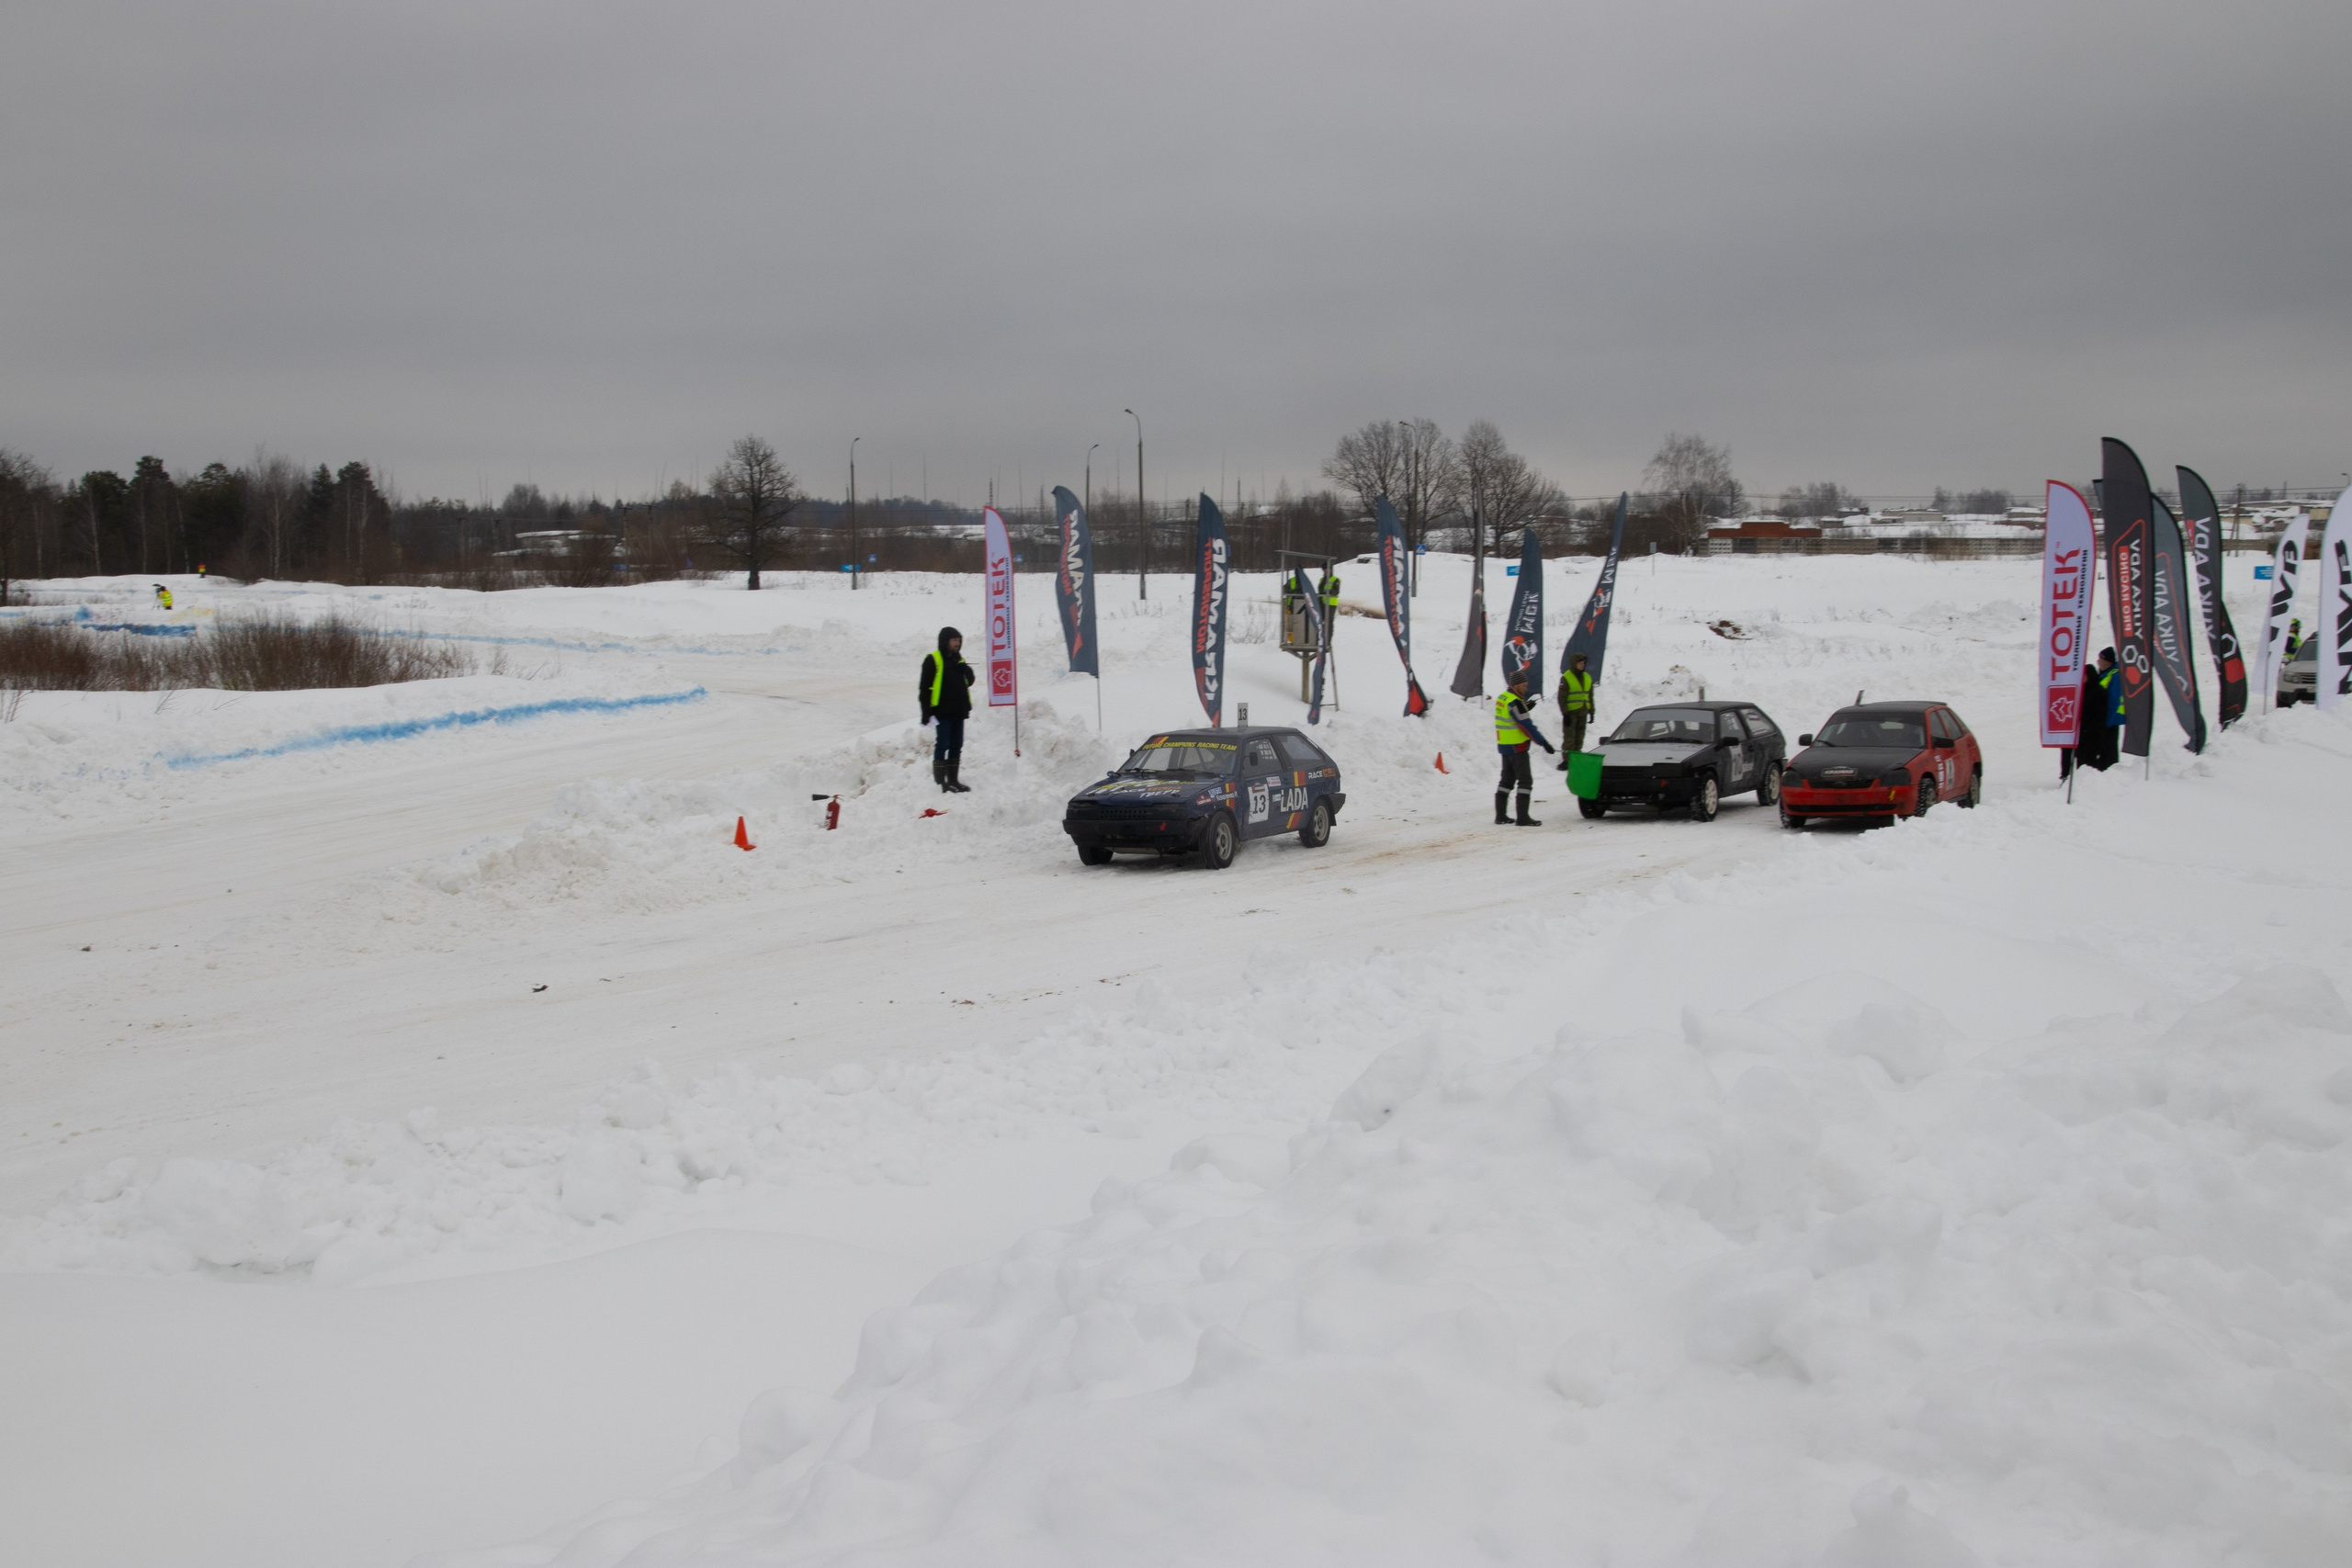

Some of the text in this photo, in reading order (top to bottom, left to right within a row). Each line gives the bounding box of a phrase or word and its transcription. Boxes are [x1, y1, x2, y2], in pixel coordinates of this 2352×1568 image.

[1238, 708, 1248, 721] 13
[1197, 741, 1219, 750] RACING
[1219, 743, 1238, 751] TEAM
[1307, 771, 1323, 780] RACE
[1252, 795, 1266, 814] 13
[1280, 787, 1308, 812] LADA
